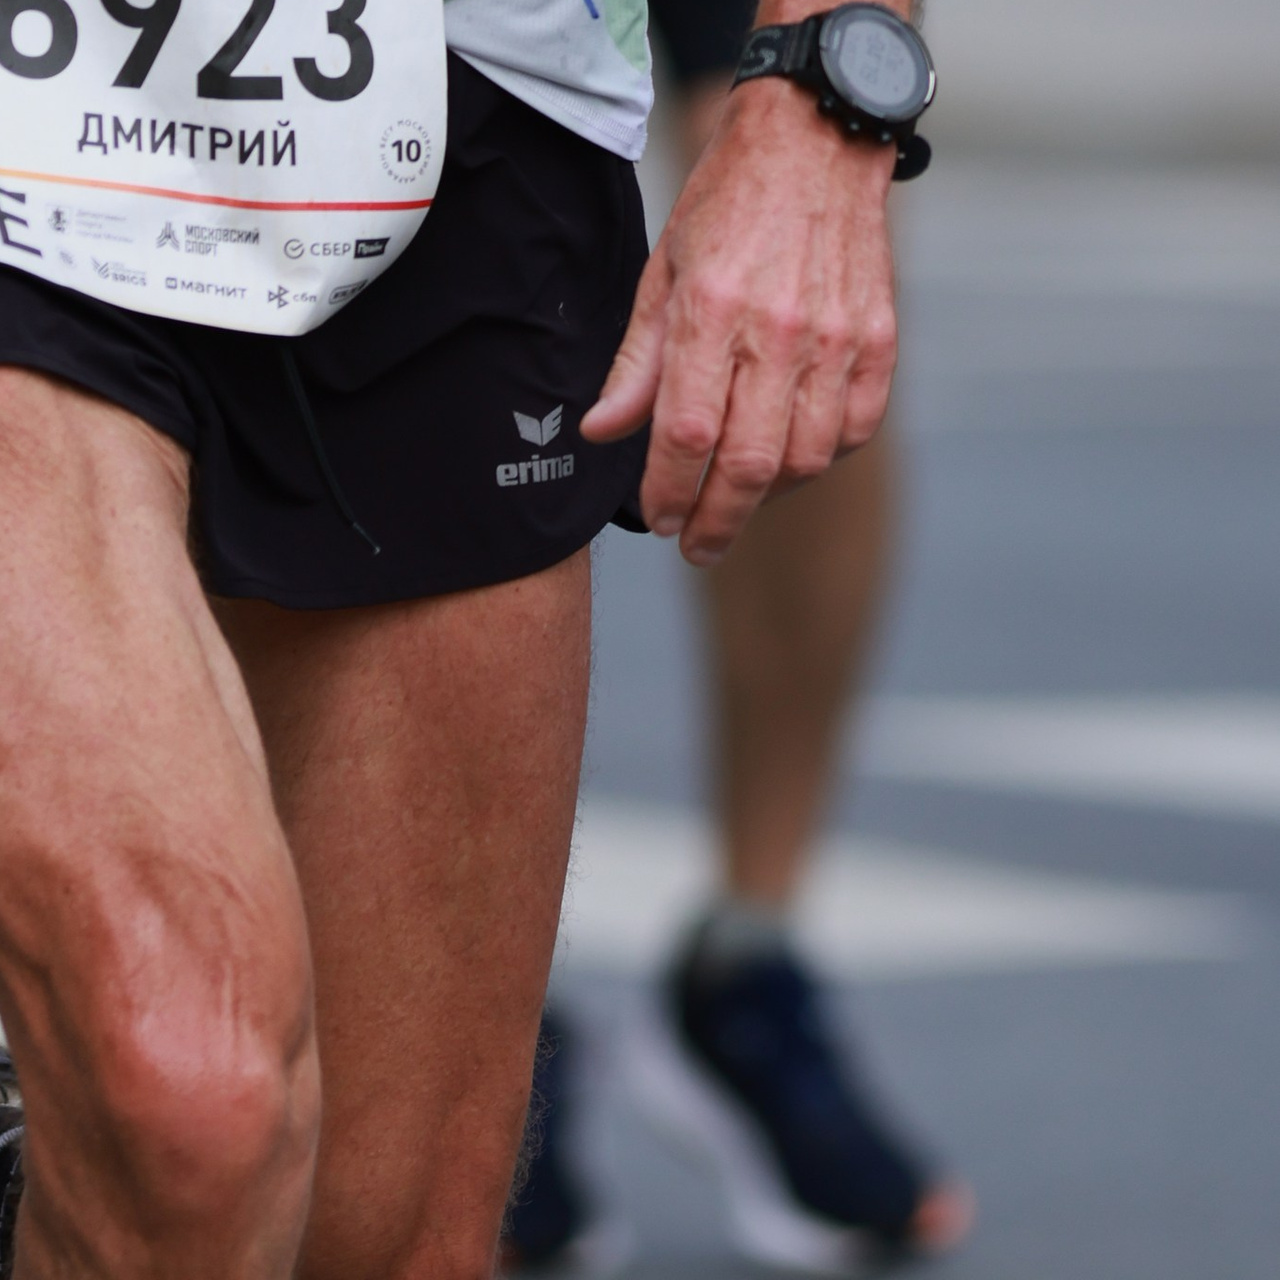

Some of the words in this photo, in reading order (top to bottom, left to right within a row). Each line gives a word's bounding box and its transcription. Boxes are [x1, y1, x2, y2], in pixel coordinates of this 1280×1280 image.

[78, 112, 297, 166] ДМИТРИЙ
[391, 139, 422, 163] 10
[185, 223, 260, 245] МОСКОВСКИЙ
[185, 240, 218, 257] СПОРТ
[310, 242, 351, 256] СБЕР
[496, 454, 574, 487] erima
